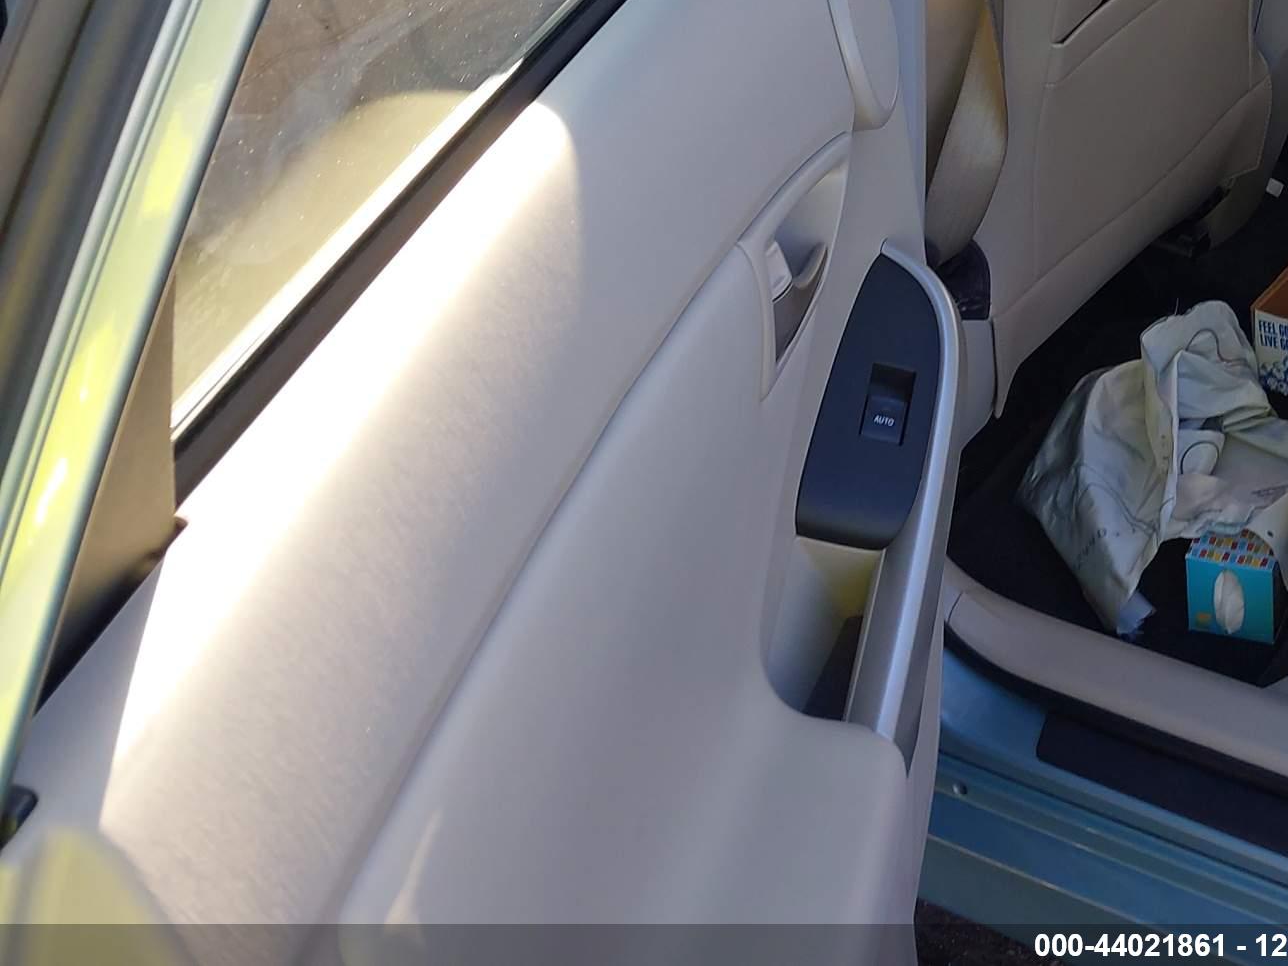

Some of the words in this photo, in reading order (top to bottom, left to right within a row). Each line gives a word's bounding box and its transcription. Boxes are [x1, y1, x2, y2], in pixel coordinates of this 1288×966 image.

[1258, 320, 1277, 335] FEEL
[1260, 333, 1277, 348] LIVE
[873, 414, 895, 427] AUTO
